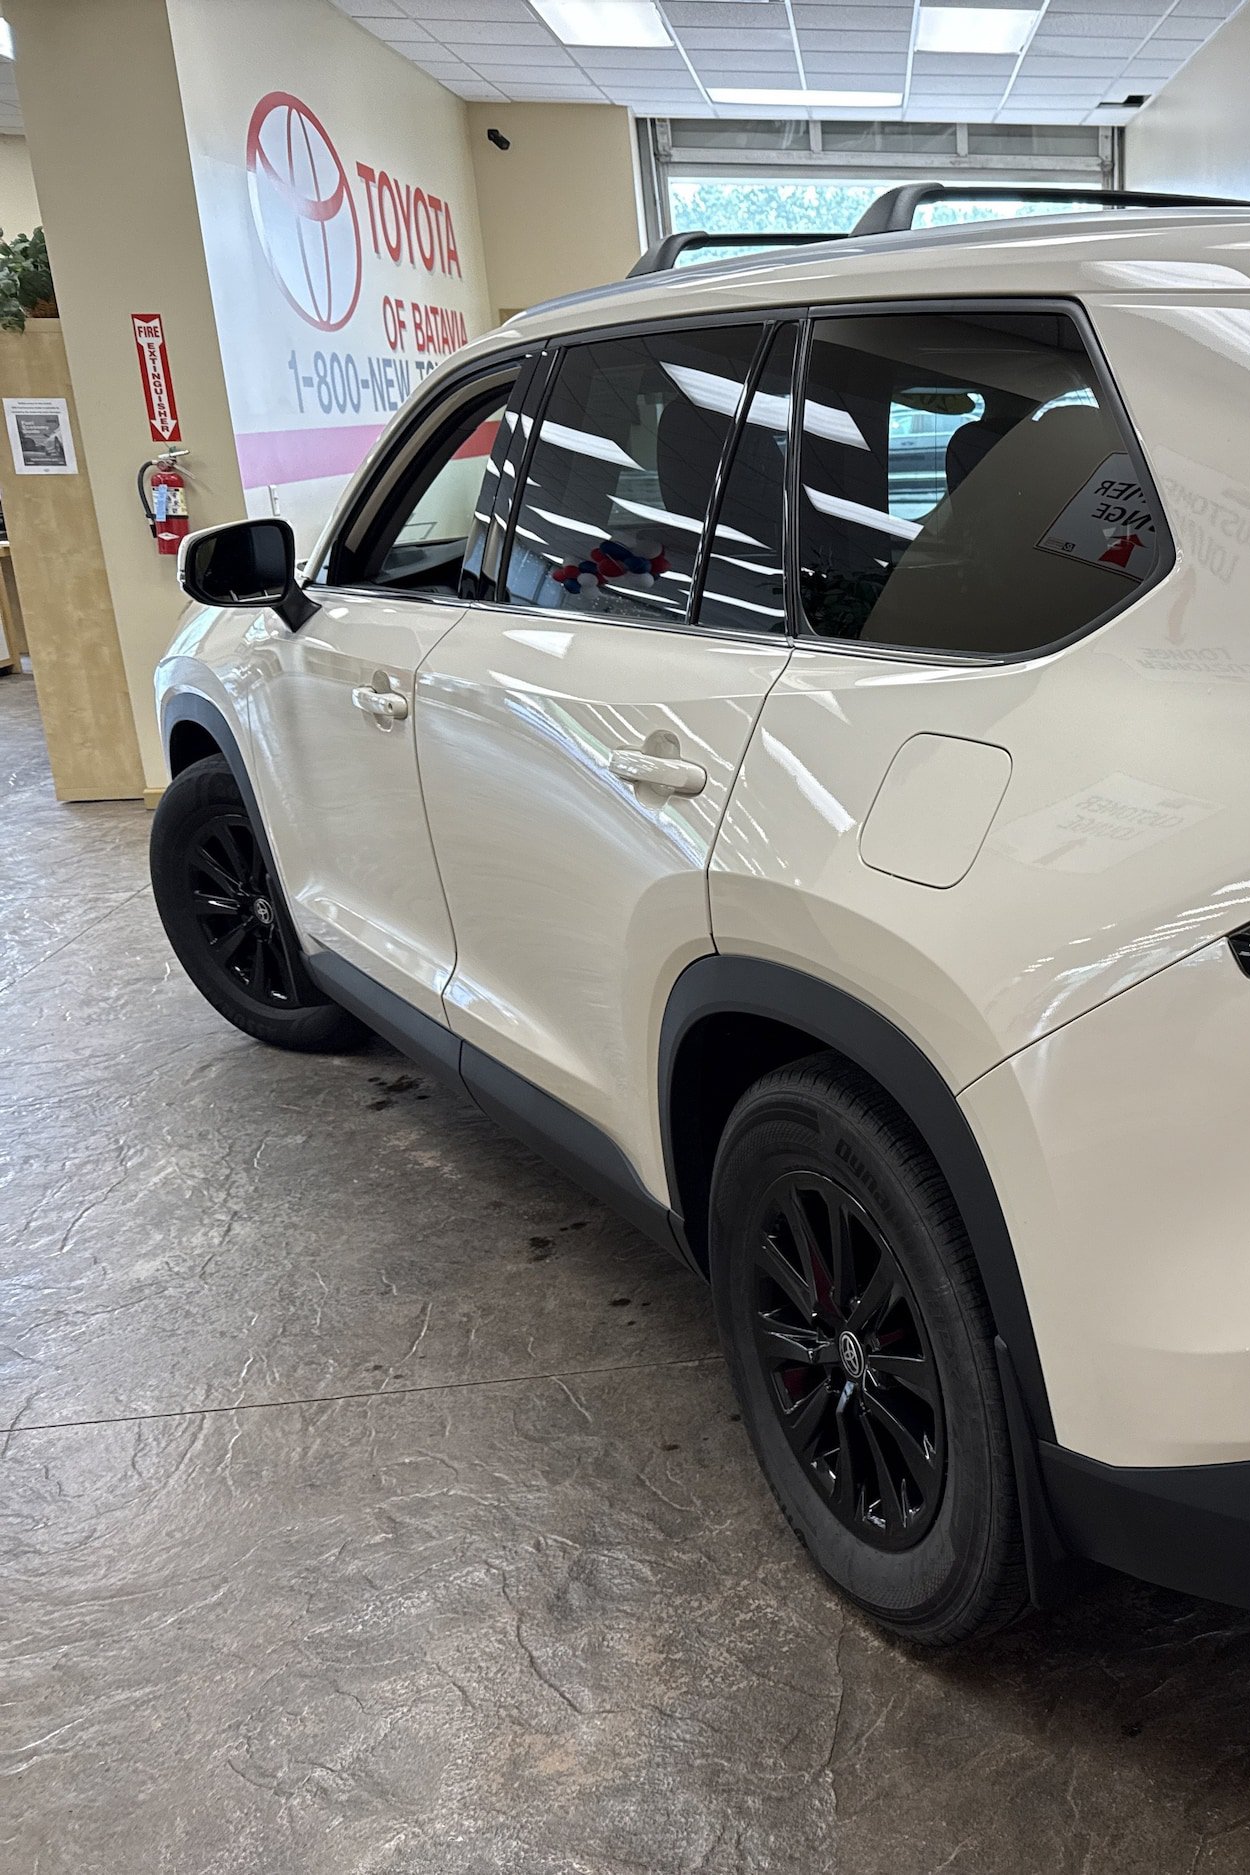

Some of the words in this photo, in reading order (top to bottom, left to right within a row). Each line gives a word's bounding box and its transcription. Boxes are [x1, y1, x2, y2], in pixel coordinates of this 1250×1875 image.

[356, 161, 464, 279] TOYOTA
[137, 326, 160, 338] FIRE
[383, 295, 407, 351] OF
[411, 302, 469, 355] BATAVIA
[147, 343, 170, 433] EXTINGUISHER
